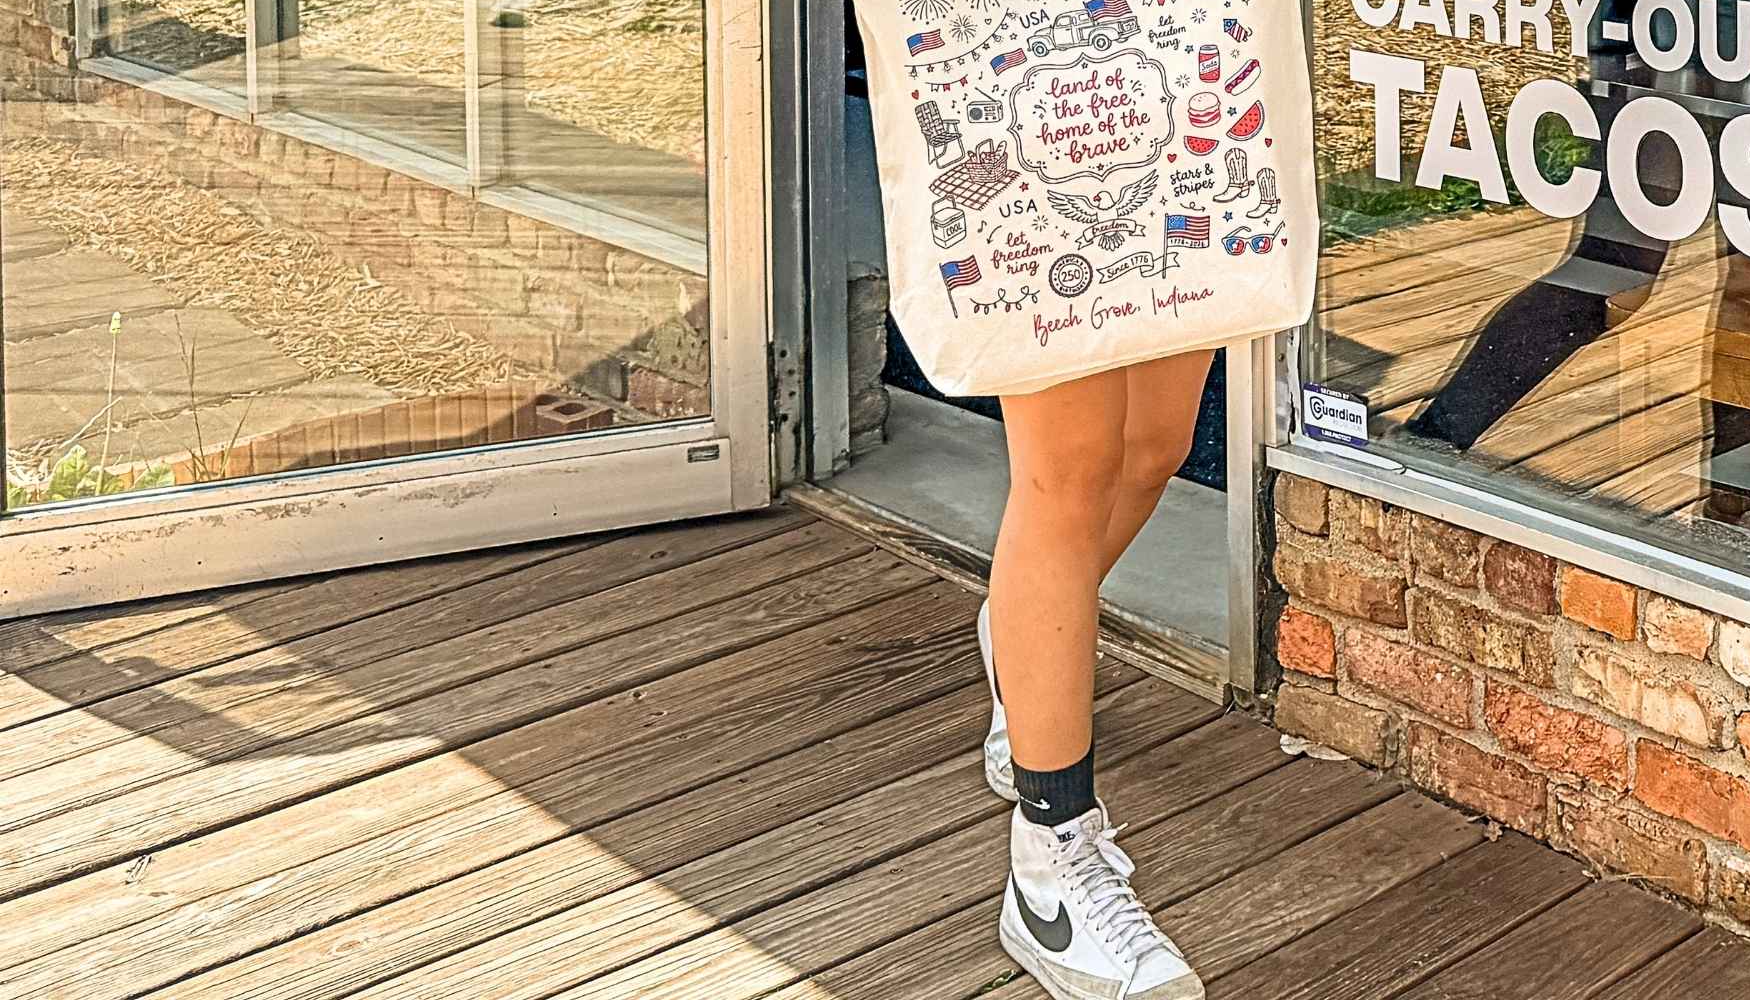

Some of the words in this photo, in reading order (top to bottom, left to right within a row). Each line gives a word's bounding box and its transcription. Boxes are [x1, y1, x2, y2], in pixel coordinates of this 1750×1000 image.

[1019, 8, 1050, 29] USA
[1159, 15, 1175, 27] let
[1148, 25, 1186, 43] freedom
[1156, 38, 1181, 51] ring
[1045, 70, 1101, 98] land
[1105, 68, 1125, 90] of
[1052, 99, 1083, 119] the
[1087, 92, 1136, 118] free,
[1036, 122, 1093, 145] home
[1098, 112, 1117, 136] of
[1120, 108, 1150, 128] the
[1064, 137, 1130, 163] brave
[1170, 168, 1201, 185] stars
[1204, 163, 1214, 176] &
[1173, 179, 1216, 198] stripes
[999, 198, 1038, 218] USA
[991, 243, 1053, 269] freedom
[1107, 262, 1130, 280] Since
[1131, 254, 1149, 267] 1776
[1007, 259, 1040, 277] ring
[1061, 268, 1081, 282] 250
[1033, 304, 1083, 347] Beech
[1091, 296, 1141, 330] Grove,
[1151, 285, 1214, 318] Indiana
[1313, 402, 1362, 424] Guardian
